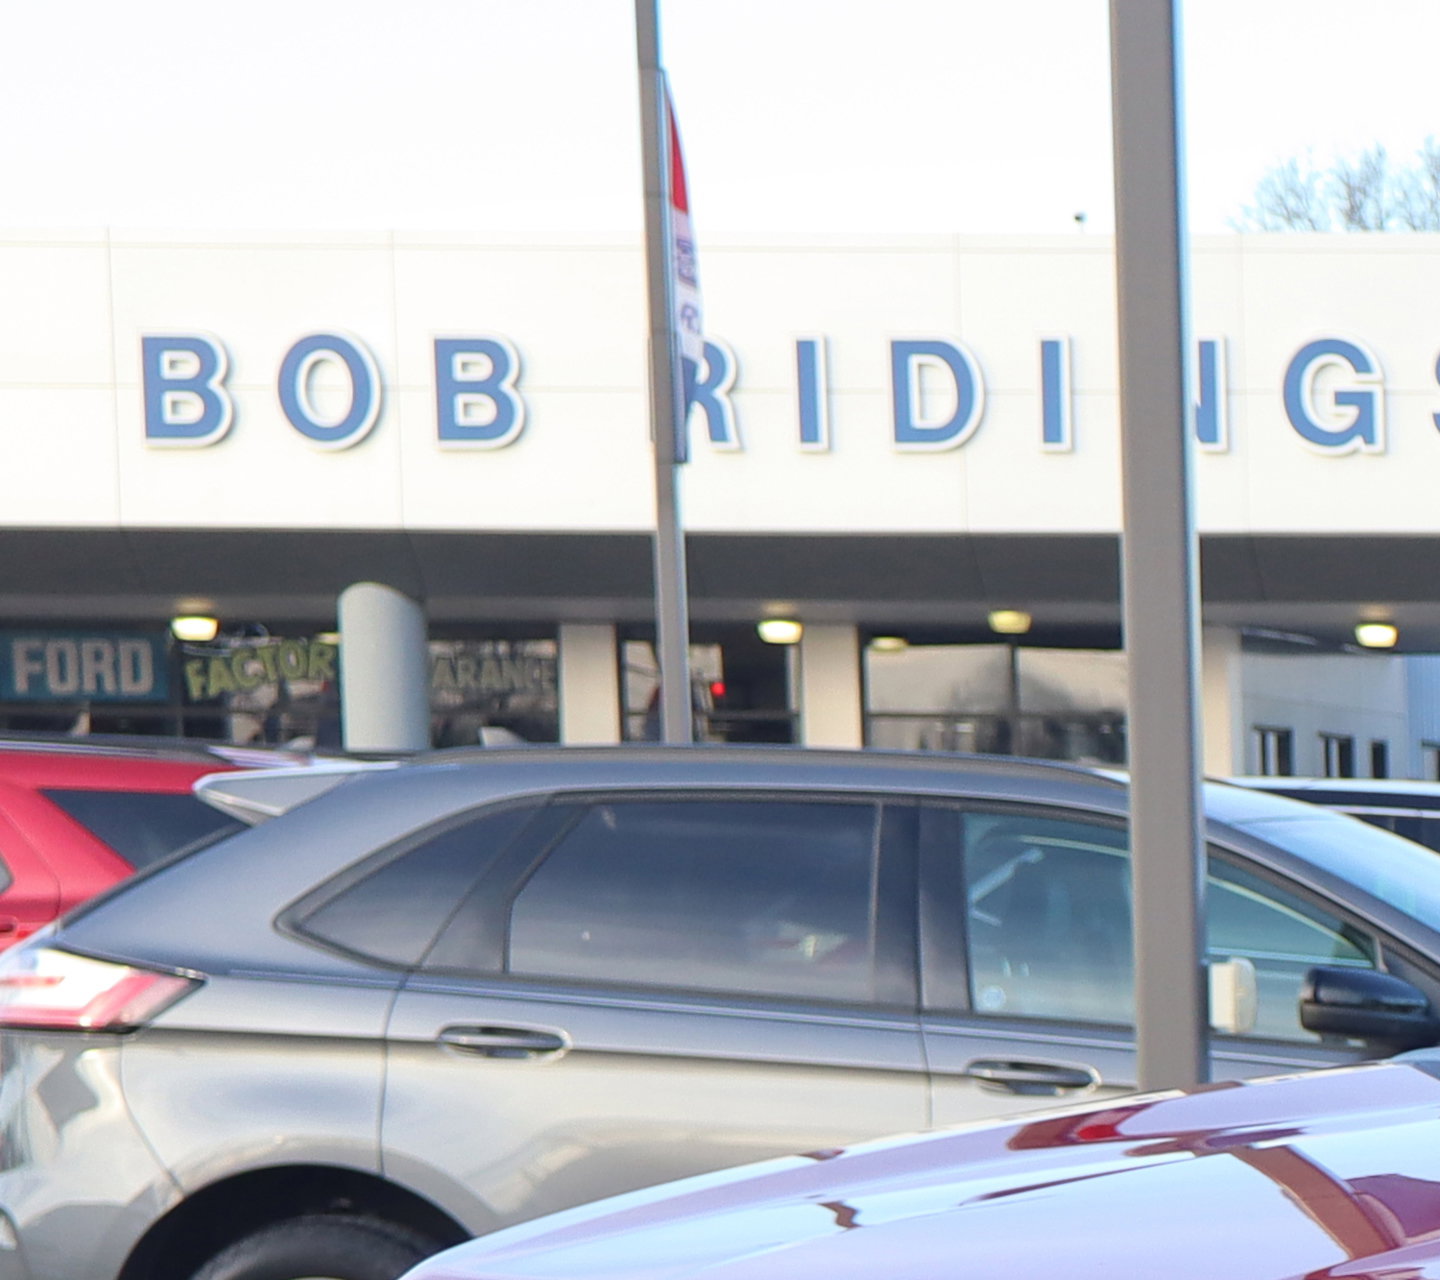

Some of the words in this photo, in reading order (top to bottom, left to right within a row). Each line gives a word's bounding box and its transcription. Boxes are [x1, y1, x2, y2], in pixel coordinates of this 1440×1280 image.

[141, 332, 524, 449] BOB
[12, 637, 154, 695] FORD
[184, 639, 336, 699] FACTOR
[431, 656, 557, 697] ARANCE
